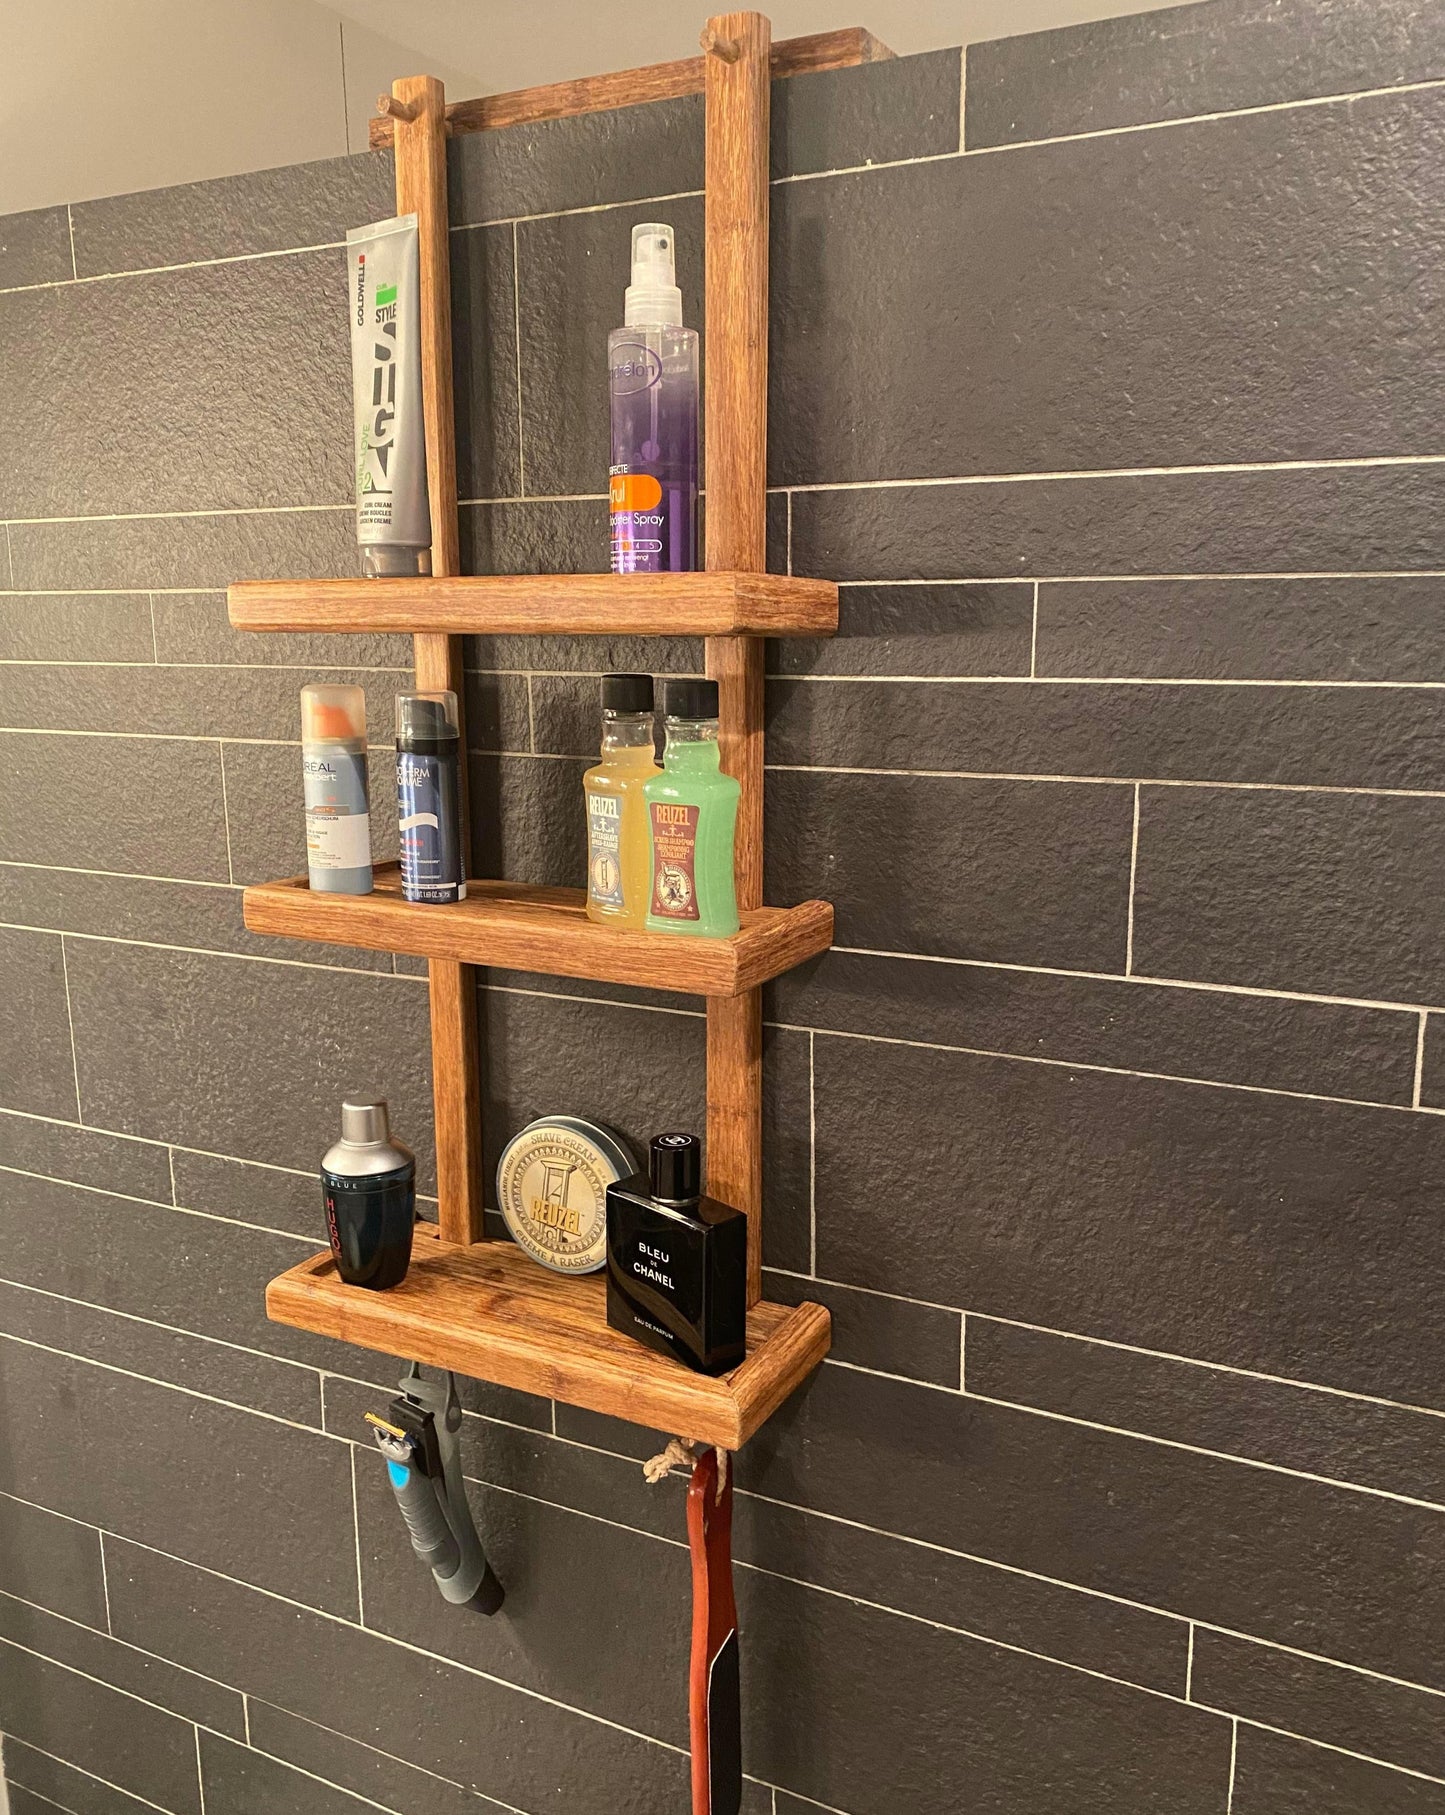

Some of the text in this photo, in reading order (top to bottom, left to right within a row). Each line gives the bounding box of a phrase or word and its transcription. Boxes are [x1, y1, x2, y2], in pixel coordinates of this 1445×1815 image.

[357, 263, 366, 328] GOLDWELL
[376, 303, 397, 324] STYLE
[361, 423, 371, 457] LOVE
[364, 471, 372, 489] 2
[374, 501, 392, 509] CREAM
[633, 512, 664, 527] Spray
[397, 776, 423, 787] OMME
[589, 795, 620, 819] REUZEL
[656, 804, 691, 826] REUZEL
[530, 1132, 597, 1164] SHAVE CREAM
[330, 1180, 358, 1190] BLUE
[326, 1197, 341, 1250] HUGO
[531, 1197, 581, 1236] REUZEL
[560, 1254, 596, 1268] RASER
[638, 1242, 670, 1263] BLEU
[650, 1260, 658, 1268] DE
[633, 1262, 675, 1290] CHANEL
[634, 1316, 674, 1340] EAU DE PARFUM
